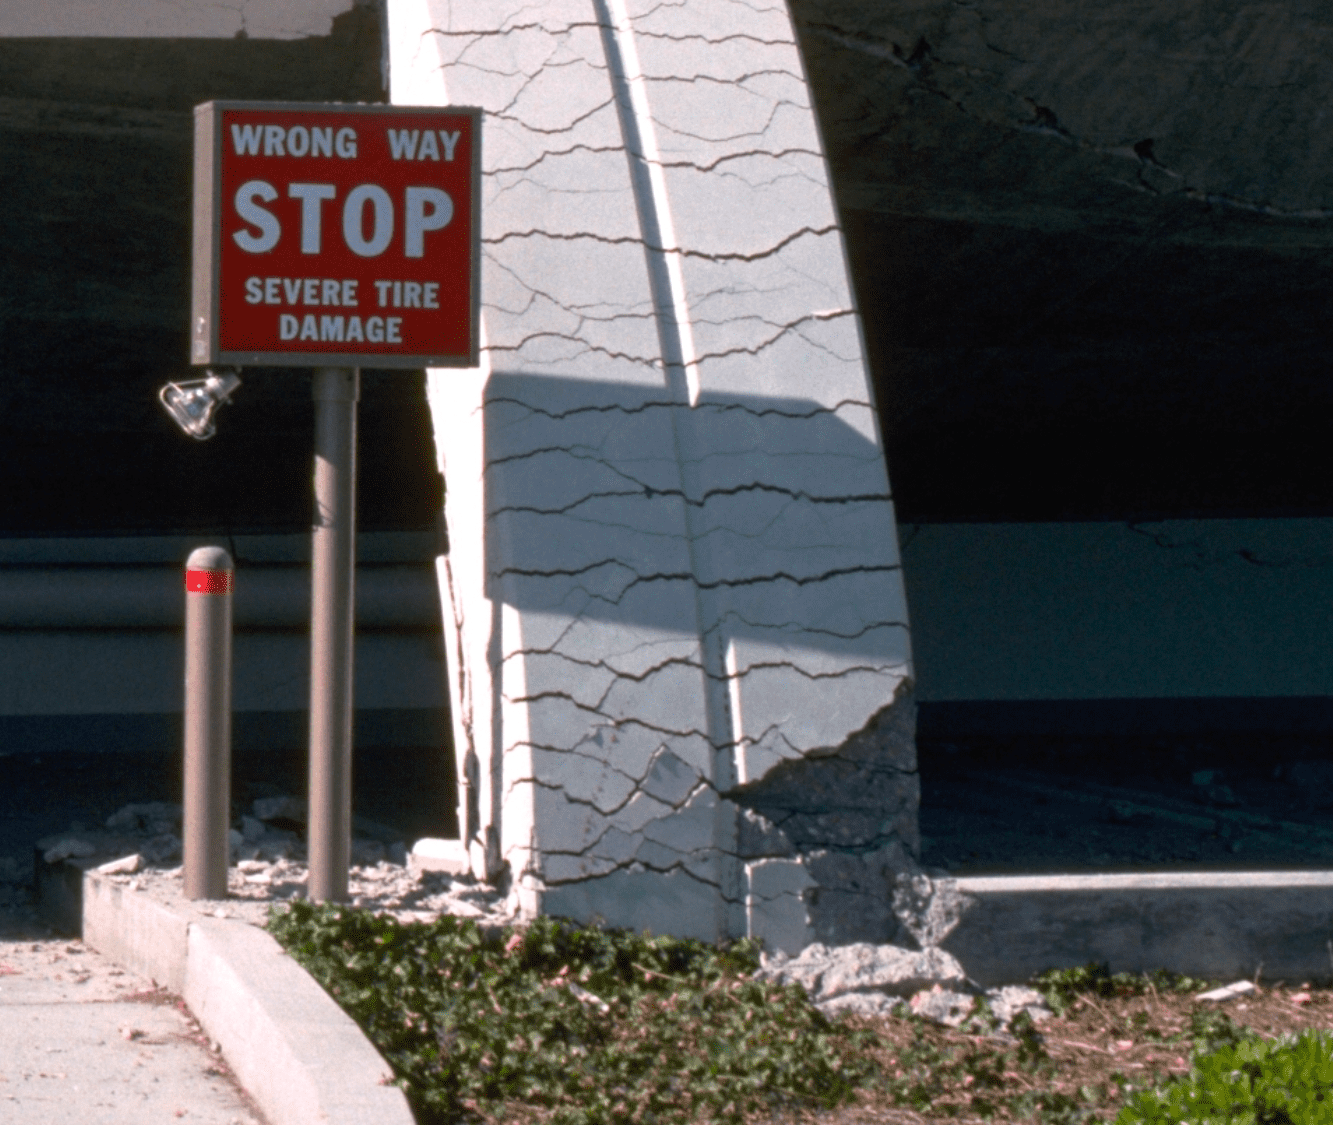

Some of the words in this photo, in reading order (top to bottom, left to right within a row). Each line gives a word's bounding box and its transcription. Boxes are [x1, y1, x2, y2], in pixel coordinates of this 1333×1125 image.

[231, 124, 357, 158] WRONG
[388, 129, 460, 161] WAY
[233, 179, 454, 258] STOP
[245, 277, 358, 306] SEVERE
[375, 281, 439, 308] TIRE
[280, 315, 402, 343] DAMAGE
